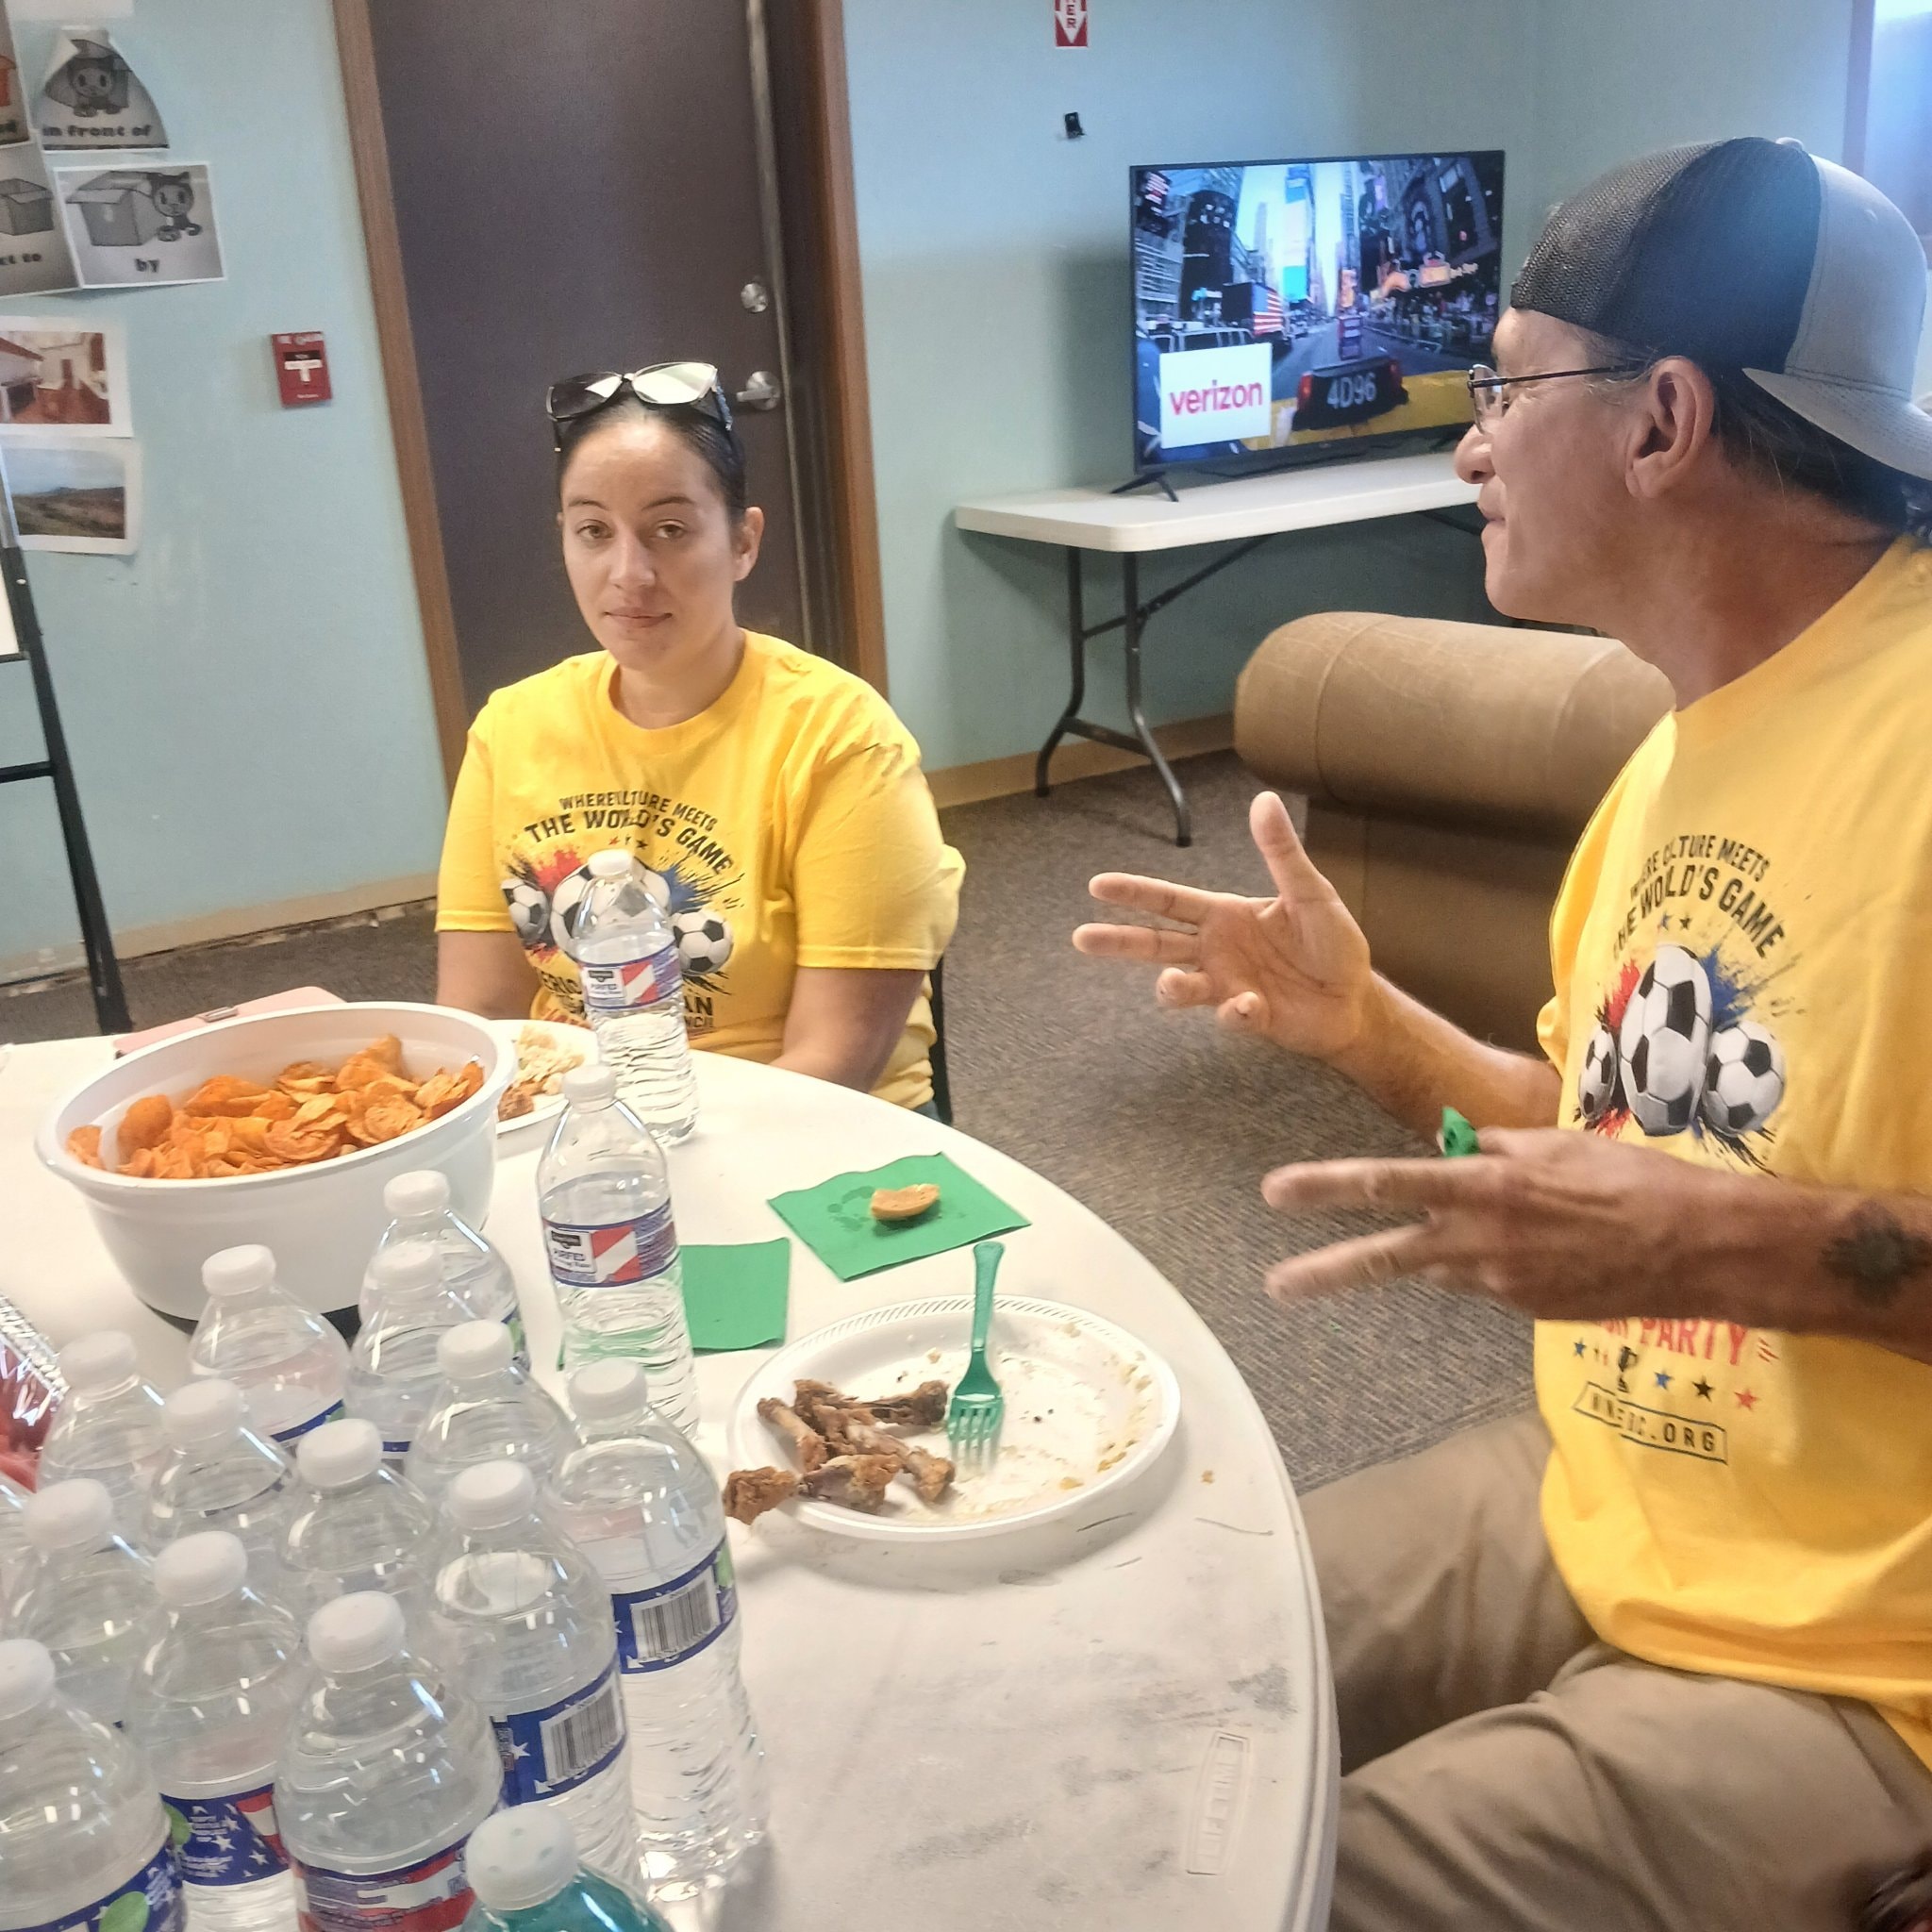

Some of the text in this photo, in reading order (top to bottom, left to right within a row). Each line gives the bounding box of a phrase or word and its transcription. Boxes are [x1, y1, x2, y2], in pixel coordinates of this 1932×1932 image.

[68, 125, 125, 137] front
[132, 125, 152, 137] of
[135, 258, 159, 273] by
[1170, 379, 1263, 415] verizon
[672, 803, 718, 832] MEETS
[525, 814, 576, 843] THE
[675, 827, 734, 875] GAME
[1717, 838, 1771, 882] MEETS
[1719, 878, 1785, 958] GAME
[1639, 1317, 1747, 1365] PARTY
